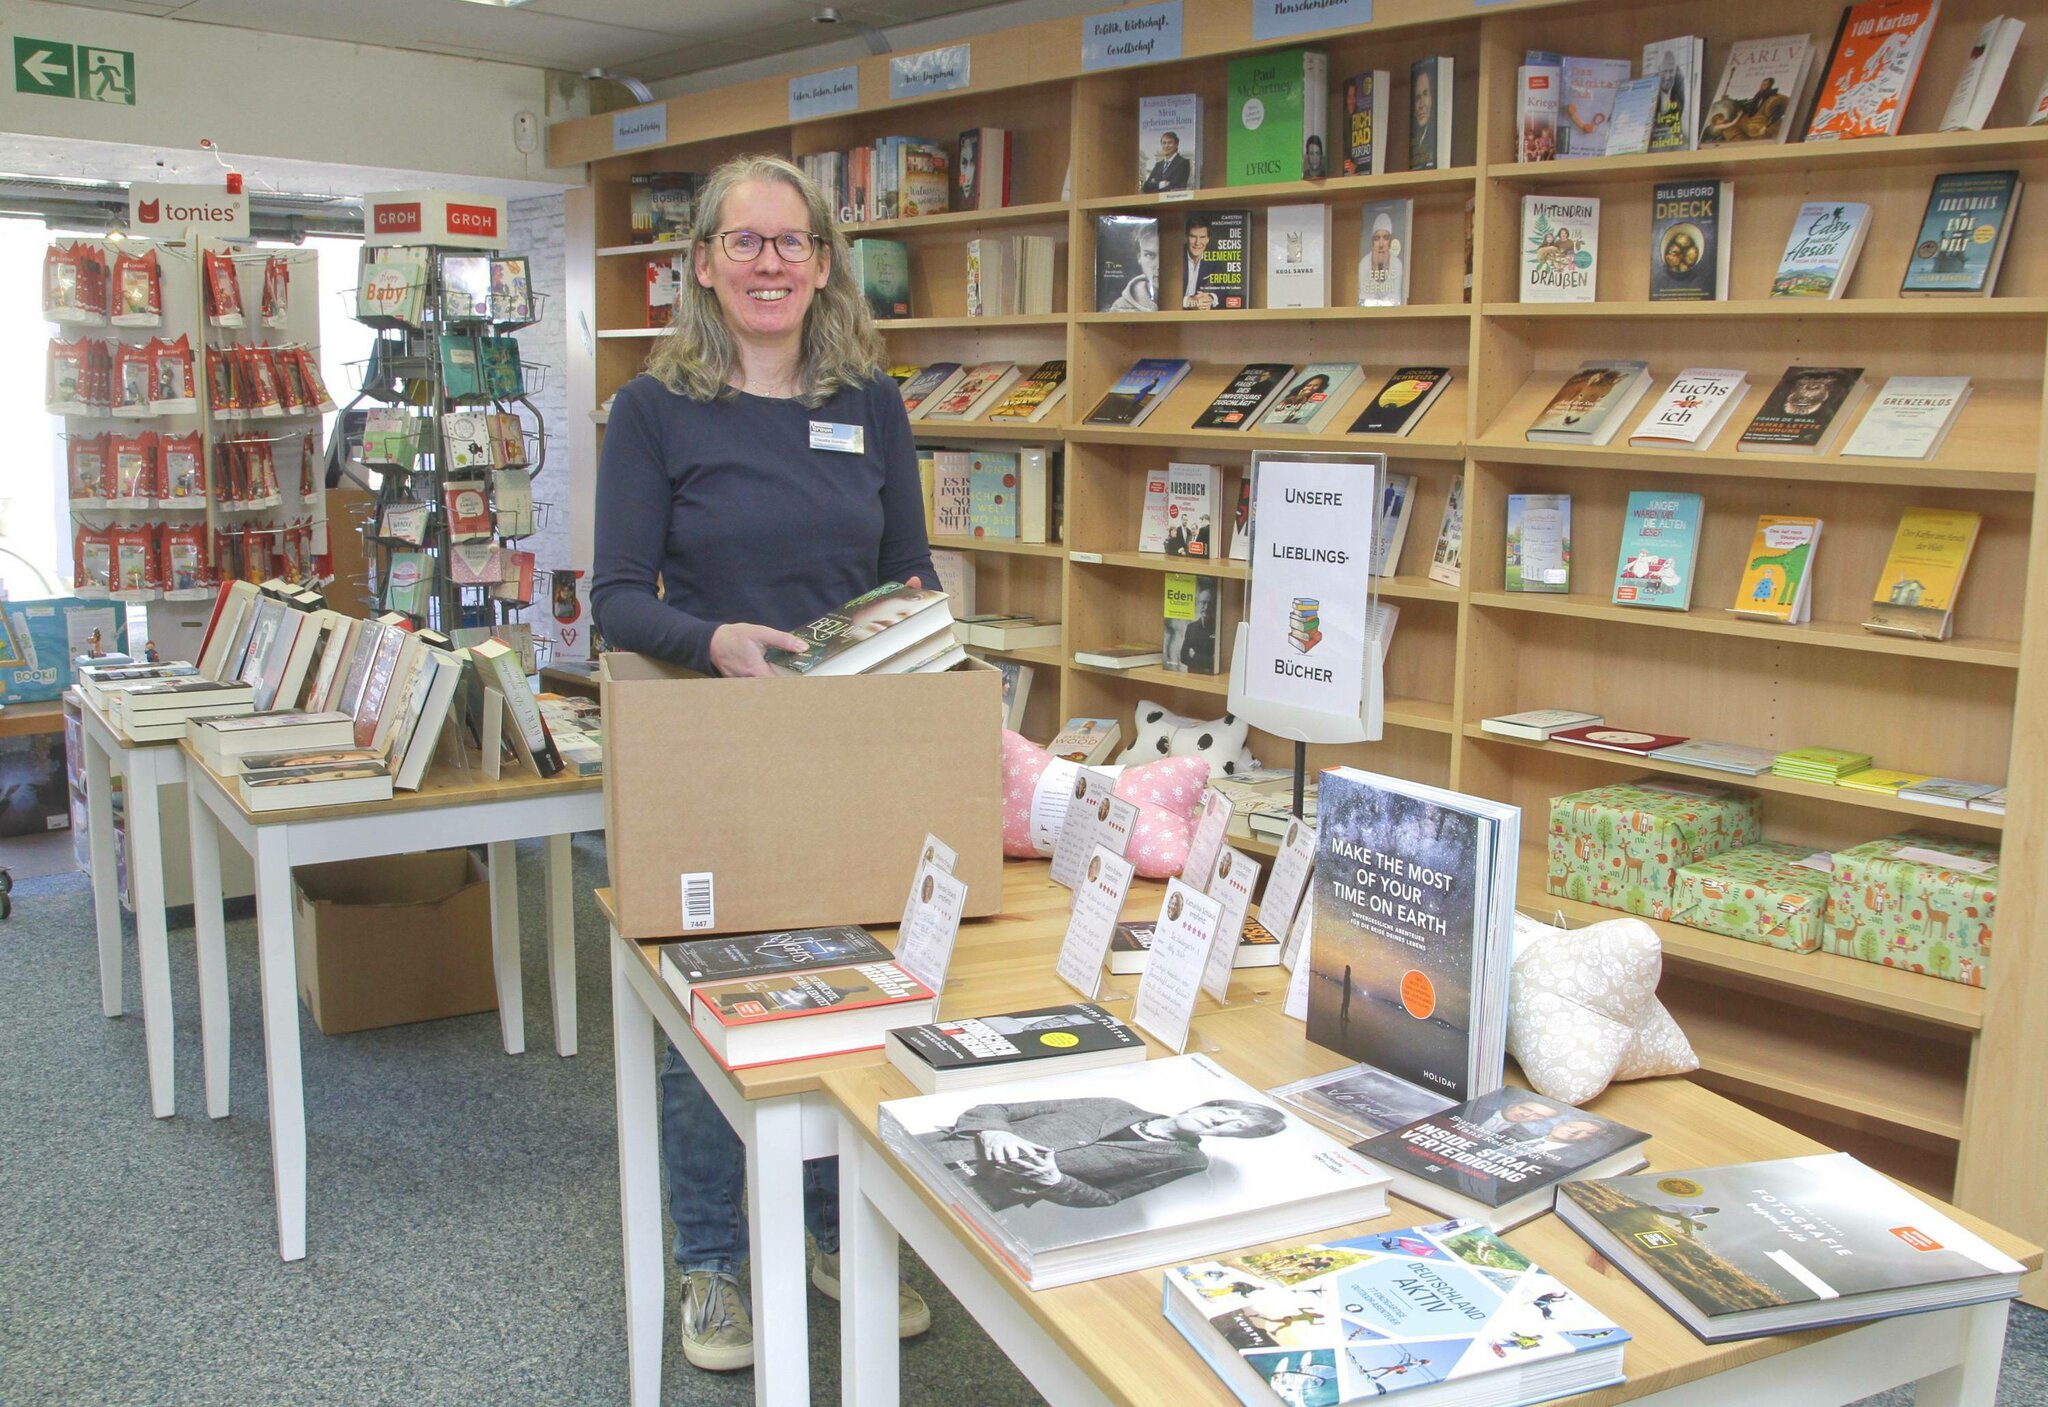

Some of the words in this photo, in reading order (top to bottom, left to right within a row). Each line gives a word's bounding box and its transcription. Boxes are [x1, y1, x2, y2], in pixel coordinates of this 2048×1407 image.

[1851, 21, 1875, 38] 100
[1876, 13, 1920, 33] Karten
[1107, 38, 1154, 56] Gesellschaft
[1730, 49, 1781, 67] KARL
[1253, 67, 1276, 83] Paul
[1571, 77, 1620, 90] digital
[1237, 80, 1293, 98] McCartney
[1352, 109, 1371, 131] RICH
[1352, 126, 1371, 147] DAD
[1246, 160, 1281, 176] LYRICS
[1657, 189, 1676, 200] BILL
[1677, 186, 1714, 199] BUFORD
[1656, 200, 1713, 219] DRECK
[379, 211, 416, 225] GROH
[451, 213, 491, 228] GROH
[1229, 228, 1242, 239] DIE
[1218, 239, 1242, 250] SECHS
[1203, 250, 1242, 261] ELEMENTE
[1226, 262, 1242, 272] DES
[1209, 273, 1242, 284] ERFOLGS
[366, 282, 409, 304] Baby!
[1670, 379, 1729, 398] Fuchs
[1882, 397, 1953, 407] GRENZENLOS
[1659, 408, 1693, 424] ich
[944, 477, 959, 486] ES
[1170, 481, 1206, 497] AUSBRUCH
[939, 516, 960, 528] MIT
[1642, 518, 1658, 528] DIE
[1659, 519, 1687, 530] ALTEN
[1167, 589, 1194, 602] Eden
[1330, 837, 1371, 865] MAKE
[1375, 851, 1403, 876] THE
[1408, 863, 1453, 892] MOST
[1355, 868, 1376, 886] OF
[1379, 876, 1421, 905] YOUR
[1332, 881, 1365, 906] TIME
[1369, 895, 1392, 917] ON
[1397, 905, 1447, 936] EARTH
[690, 920, 708, 929] 7447
[1351, 910, 1394, 934] UNVERGESSLICHE
[1394, 926, 1425, 943] ABENTEUER
[1350, 917, 1360, 927] FÜR
[1360, 920, 1370, 930] DIE
[1370, 923, 1385, 936] REISE
[1385, 928, 1405, 943] DEINES
[1405, 935, 1426, 951] LEBENS
[1098, 1017, 1131, 1043] FLEITER
[1423, 1069, 1457, 1090] HOLIDAY
[1449, 1114, 1505, 1138] Burkhard
[1415, 1123, 1476, 1151] INSIDE
[1479, 1146, 1542, 1176] STRAF-
[1451, 1122, 1482, 1139] Hans
[1482, 1133, 1542, 1162] Reinhardt
[1399, 1130, 1527, 1184] VERTEIDIGUNG
[1752, 1188, 1855, 1256] FOTOGRAFIE
[1392, 1278, 1453, 1313] AKTIV
[1407, 1262, 1487, 1320] DEUTSCHLAND
[1233, 1315, 1266, 1347] KUNTH
